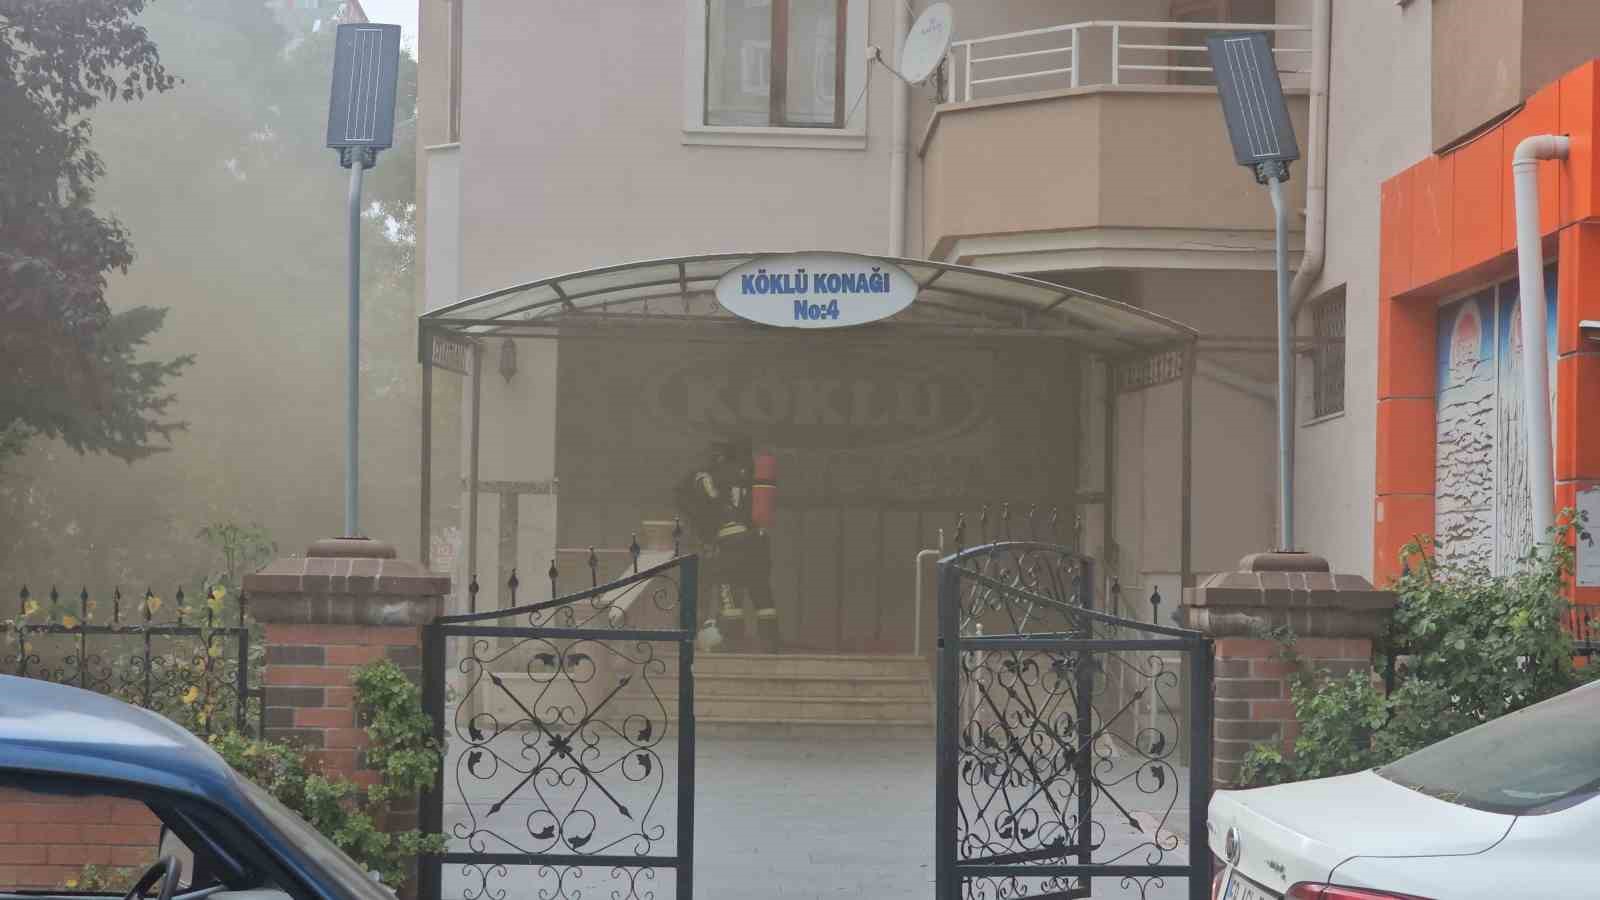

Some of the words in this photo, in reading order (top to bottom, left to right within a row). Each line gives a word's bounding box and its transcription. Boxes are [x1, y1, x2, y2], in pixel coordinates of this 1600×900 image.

[741, 269, 808, 295] KÖKLÜ
[814, 267, 891, 294] KONAĞI
[794, 300, 840, 320] No:4
